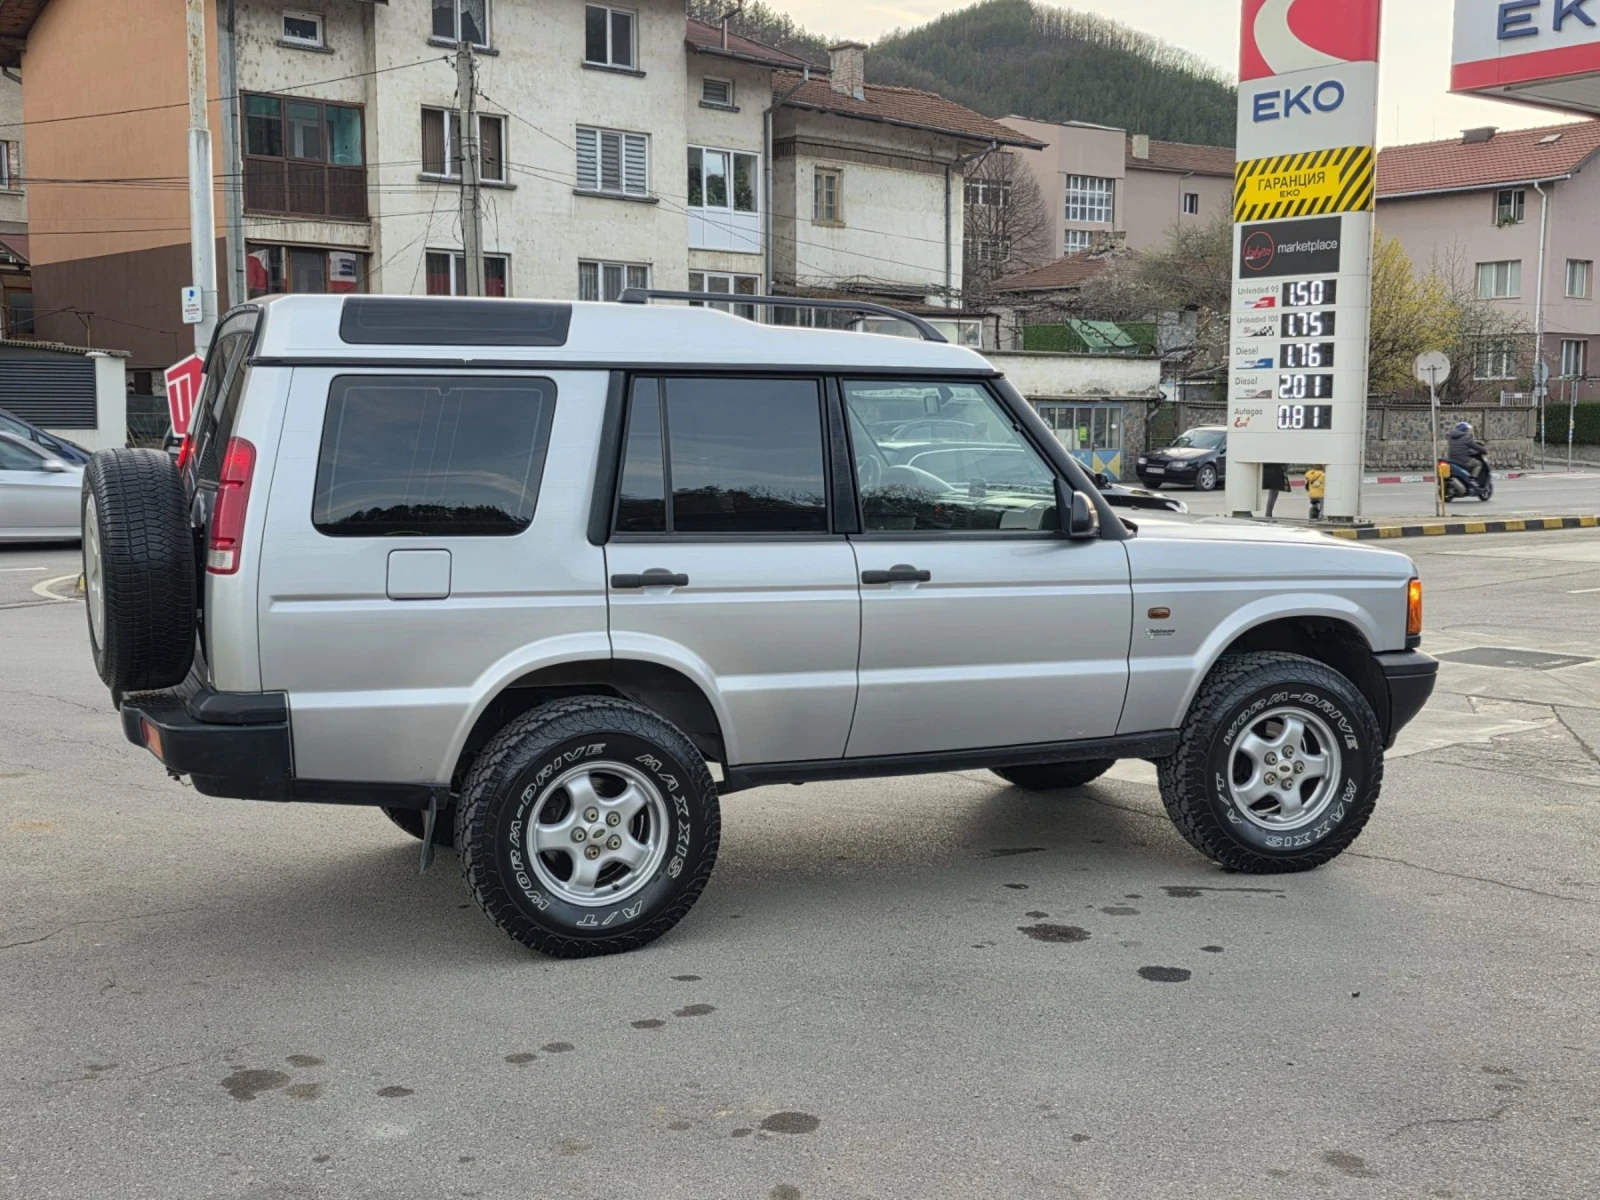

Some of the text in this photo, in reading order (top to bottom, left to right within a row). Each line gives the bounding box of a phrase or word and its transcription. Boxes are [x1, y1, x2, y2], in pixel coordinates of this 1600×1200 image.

[1253, 80, 1345, 122] EKO
[1258, 171, 1325, 191] ГАРАНЦИЯ
[1280, 189, 1300, 198] EKO
[1277, 239, 1338, 253] marketplace
[1237, 285, 1279, 295] Unleaded 95
[1289, 280, 1323, 306] 1.50
[1236, 315, 1266, 324] Unleaded
[1288, 311, 1322, 337] 1.75
[1235, 346, 1258, 356] Diesel
[1287, 343, 1320, 367] 1.76
[1234, 377, 1258, 386] Diesel
[1279, 374, 1320, 398] 2.01
[1234, 408, 1263, 417] Autogas
[1278, 405, 1319, 429] 0.81
[1223, 691, 1359, 751] WORM-DRIVE
[1215, 772, 1243, 825] A/T
[635, 753, 691, 879] MAXXIS
[1265, 778, 1357, 848] MAXXIS
[509, 743, 607, 911] WORM-DRIVE
[576, 900, 644, 927] A/T
